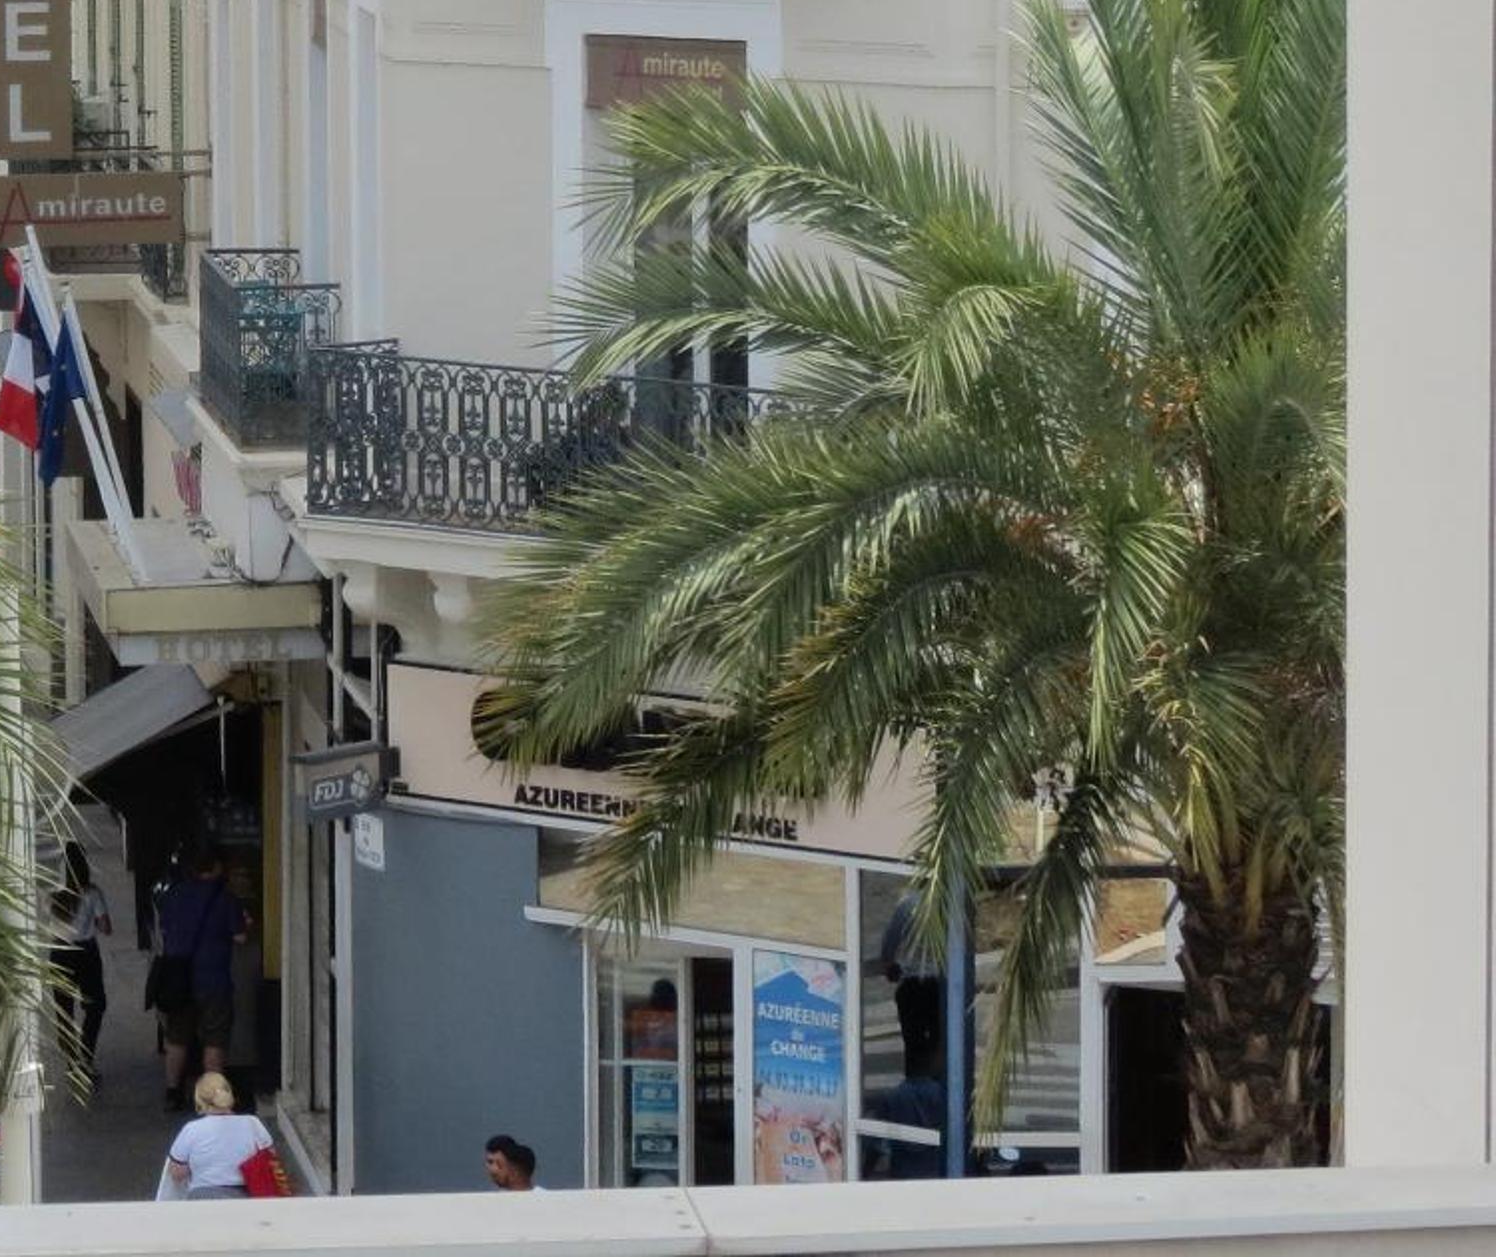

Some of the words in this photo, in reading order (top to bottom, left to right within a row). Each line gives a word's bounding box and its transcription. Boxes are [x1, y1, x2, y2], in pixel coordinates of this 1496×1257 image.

[314, 783, 345, 803] FDJ
[514, 783, 646, 819] AZUREENN
[769, 1041, 827, 1064] CHANGE
